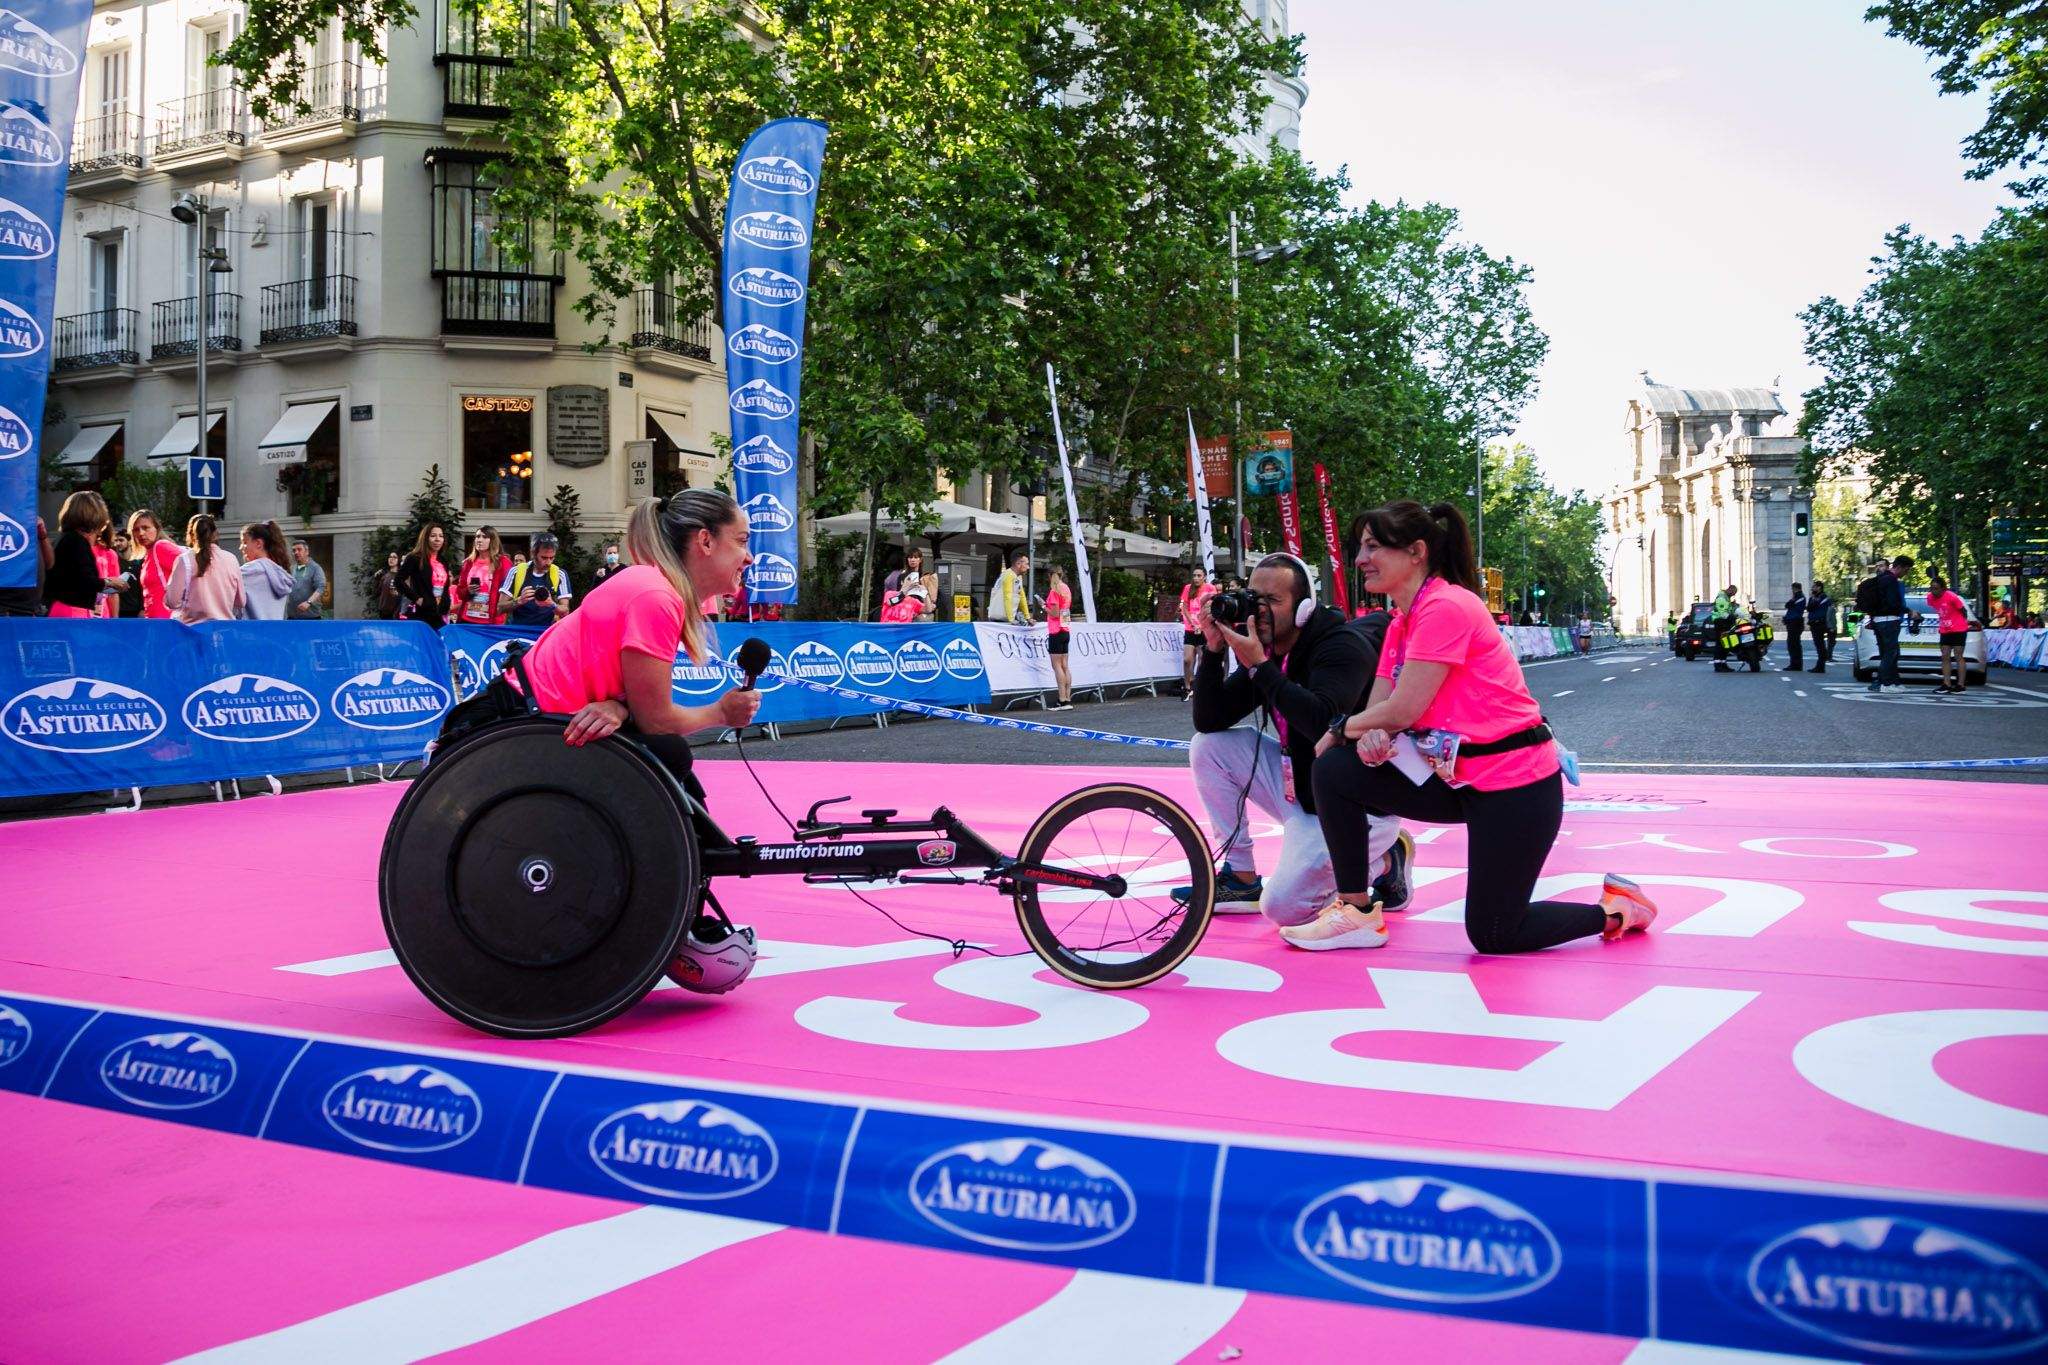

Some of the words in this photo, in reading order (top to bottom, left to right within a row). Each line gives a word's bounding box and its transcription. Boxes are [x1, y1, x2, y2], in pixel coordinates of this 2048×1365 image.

[744, 165, 808, 191] ASTURIANA
[738, 220, 804, 243] ASTURIANA
[735, 277, 798, 299] ASTURIANA
[735, 336, 792, 357] ASTURIANA
[464, 397, 532, 412] CASTIZO
[267, 450, 296, 460] CASTIZO
[631, 461, 647, 469] CAS
[634, 477, 645, 485] ZO
[1076, 630, 1127, 657] OYSHO
[793, 659, 841, 677] ASTURIANA
[850, 657, 893, 675] ASTURIANA
[899, 656, 940, 673] ASTURIANA
[38, 704, 92, 713] CENTRAL
[96, 702, 148, 710] LECHERA
[260, 695, 304, 703] LECHERA
[343, 692, 442, 717] ASTURIANA
[15, 706, 157, 735] ASTURIANA
[195, 700, 313, 728] ASTURIANA
[759, 844, 864, 860] #runforbruno
[107, 1050, 221, 1095] ASTURIANA
[331, 1085, 465, 1136] ASTURIANA
[600, 1123, 759, 1181] ASTURIANA
[923, 1165, 1116, 1230] ASTURIANA
[1312, 1209, 1539, 1278] ASTURIANA
[1772, 1256, 2042, 1332] ASTURIANA
